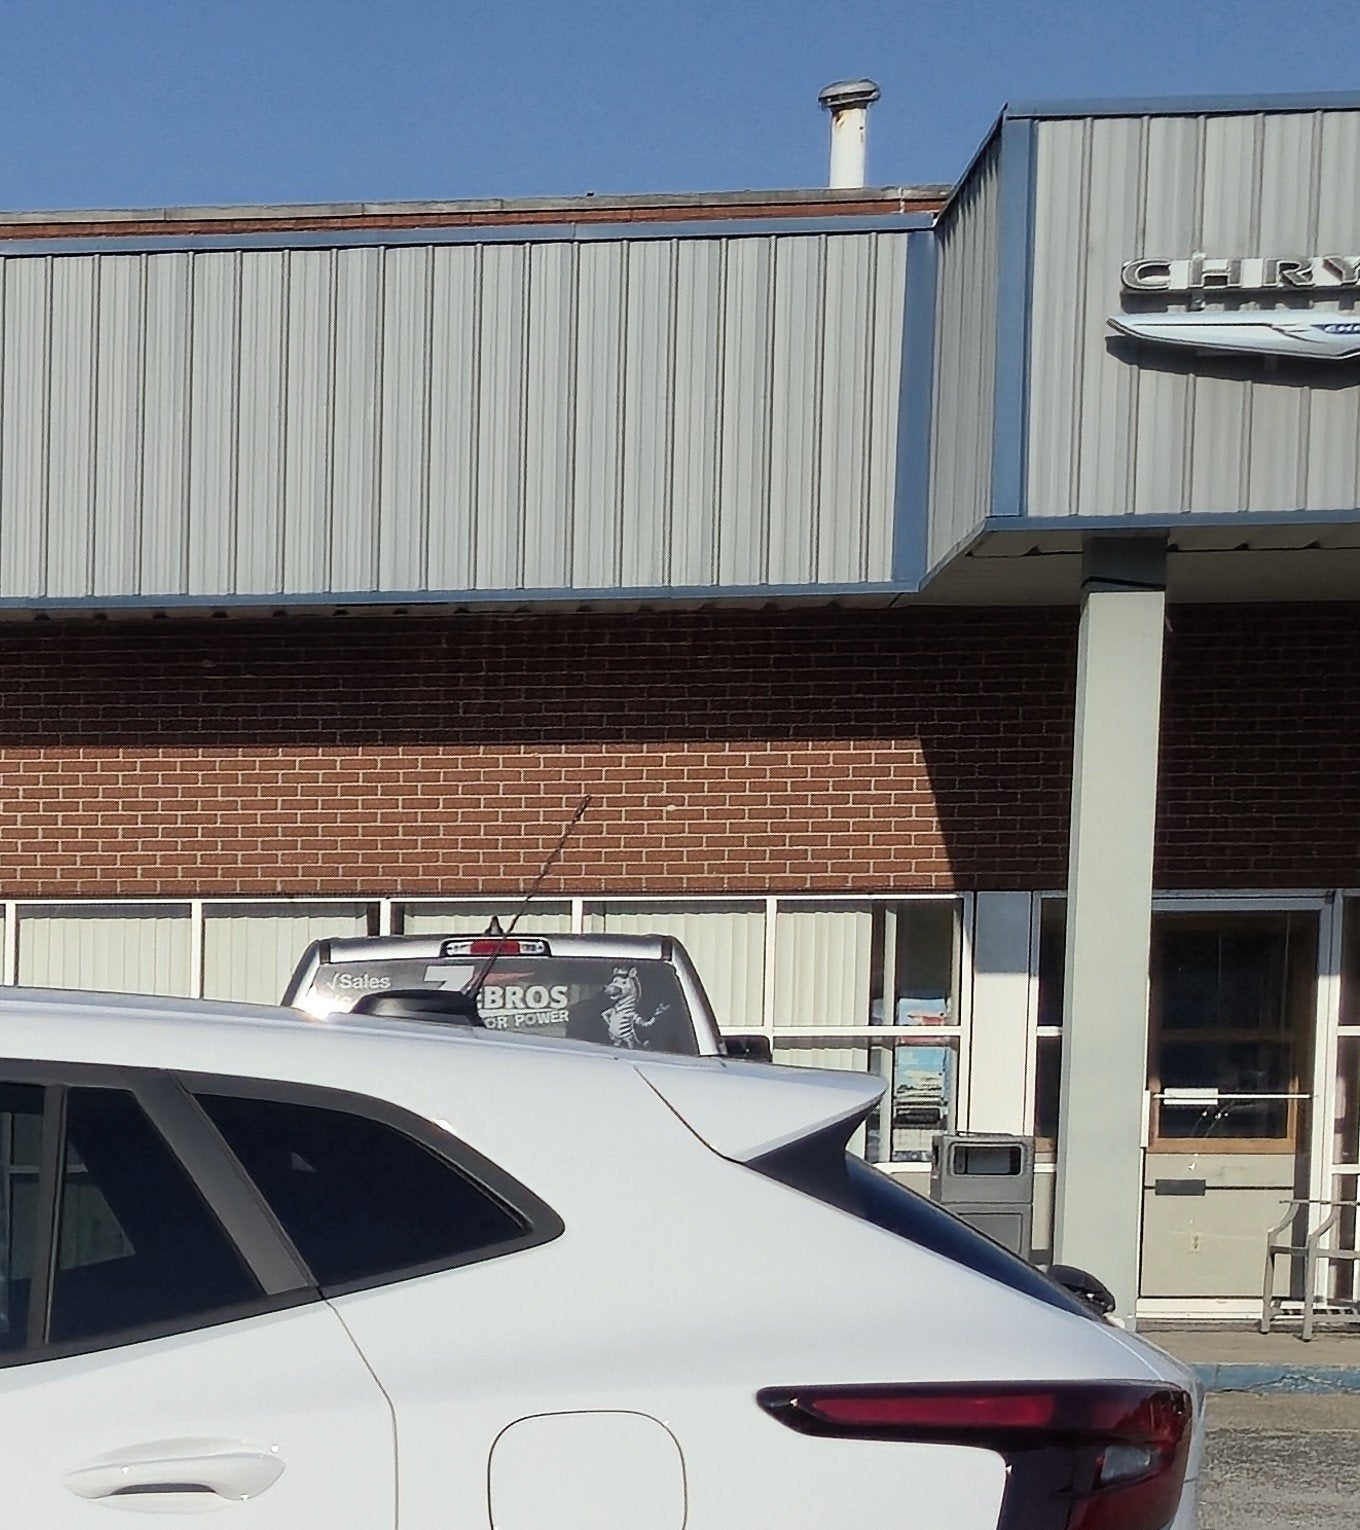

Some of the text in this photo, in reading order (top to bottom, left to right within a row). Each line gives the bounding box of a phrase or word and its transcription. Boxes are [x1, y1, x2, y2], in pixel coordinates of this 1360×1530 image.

[339, 973, 392, 989] Sales
[476, 985, 568, 1009] BROS
[514, 1009, 569, 1027] POWER
